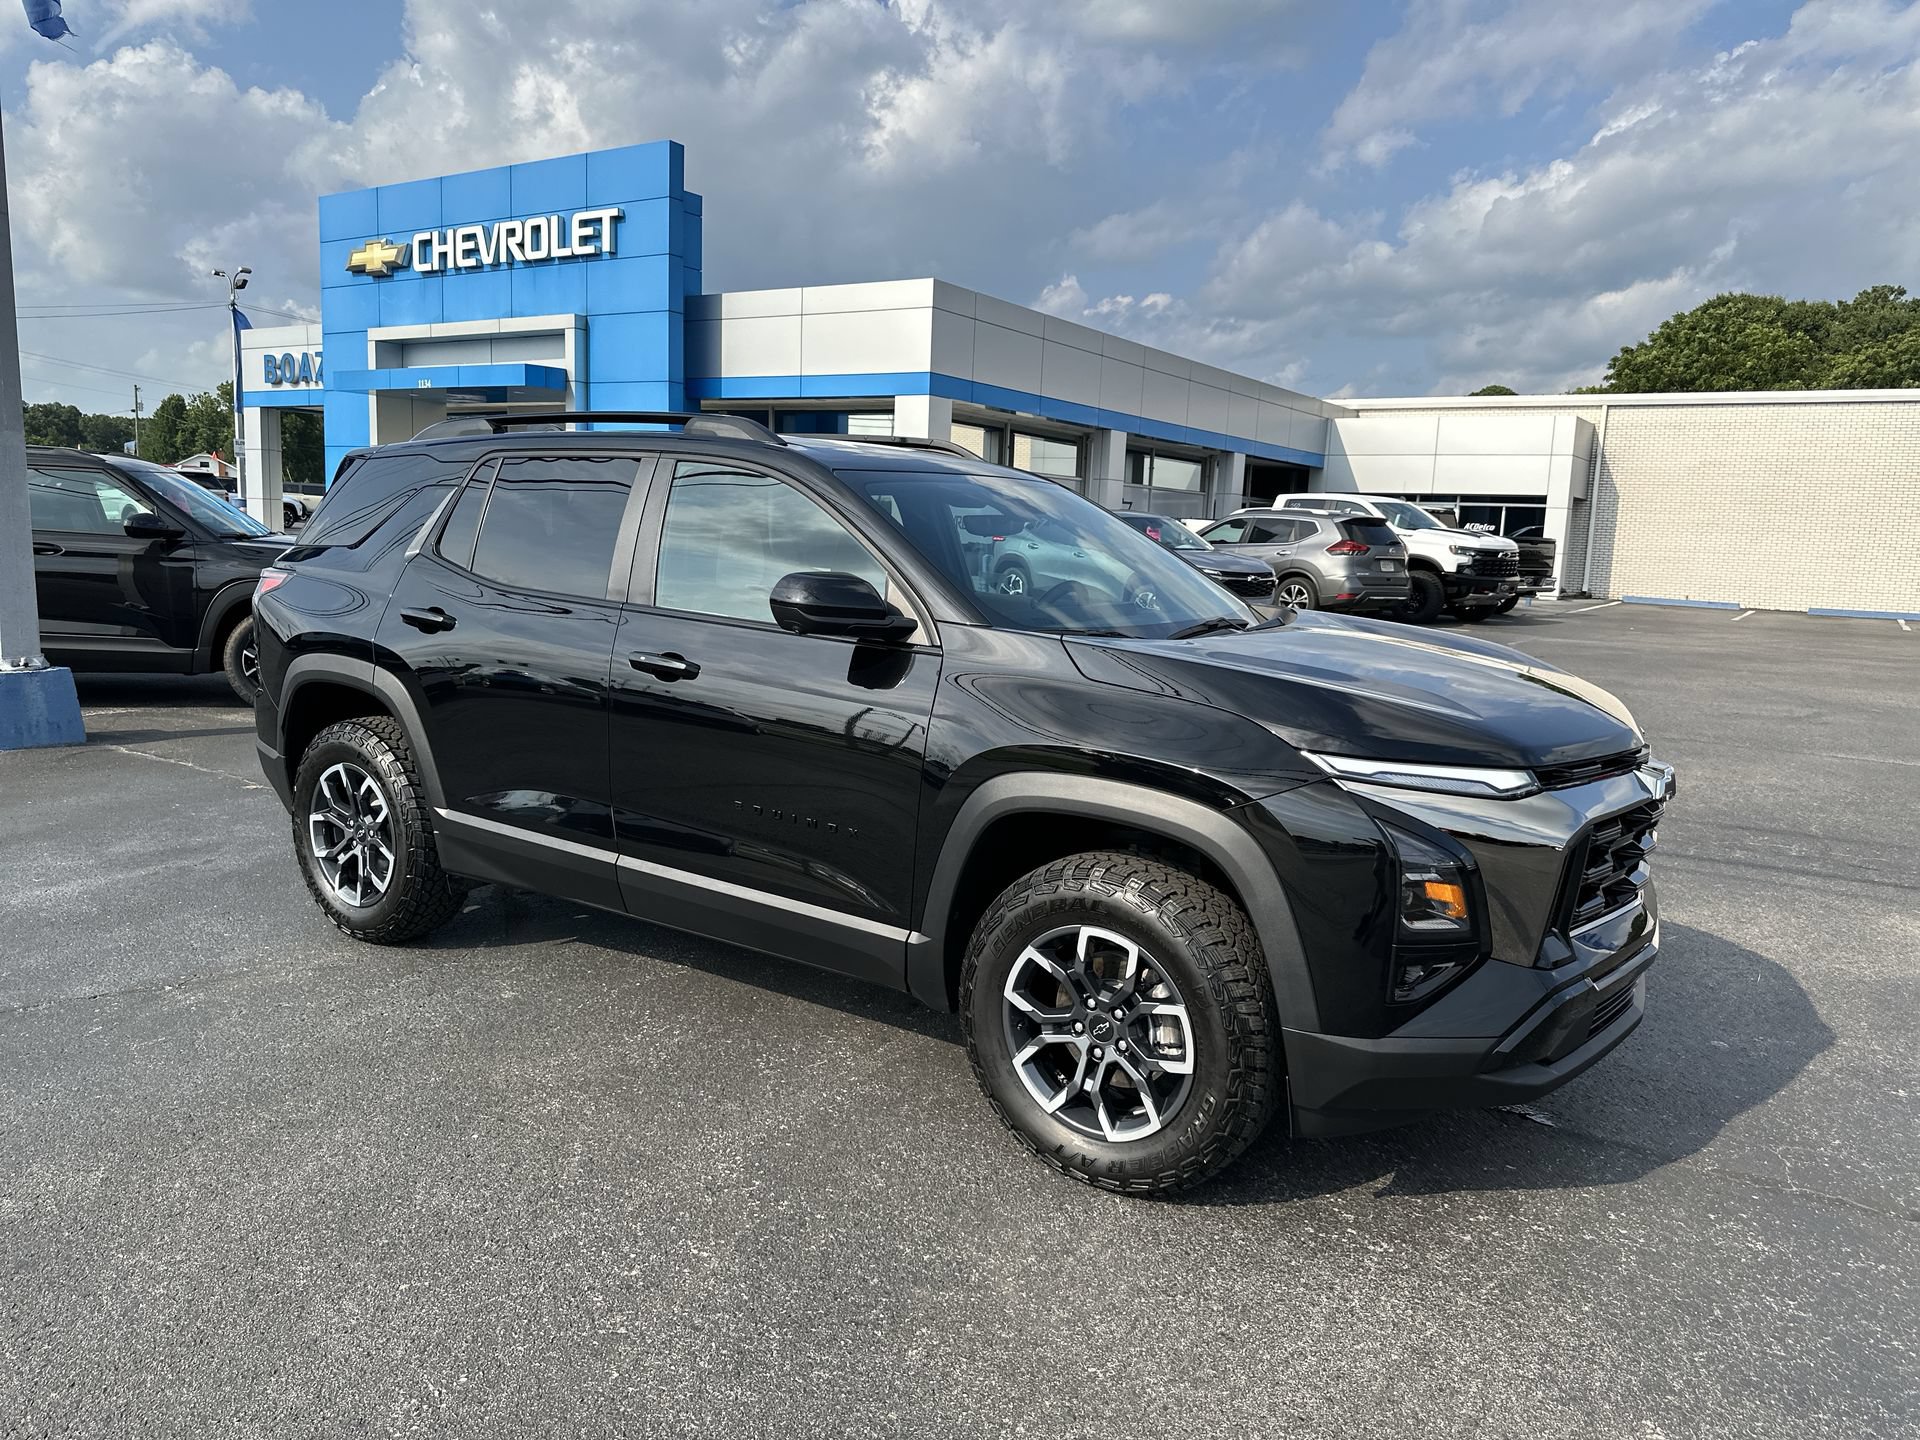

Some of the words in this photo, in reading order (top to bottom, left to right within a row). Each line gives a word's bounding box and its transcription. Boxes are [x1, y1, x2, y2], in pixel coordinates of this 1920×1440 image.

[412, 207, 622, 272] CHEVROLET
[418, 379, 431, 389] 1134
[1463, 522, 1496, 531] ACDelco
[990, 898, 1108, 959] GENERAL
